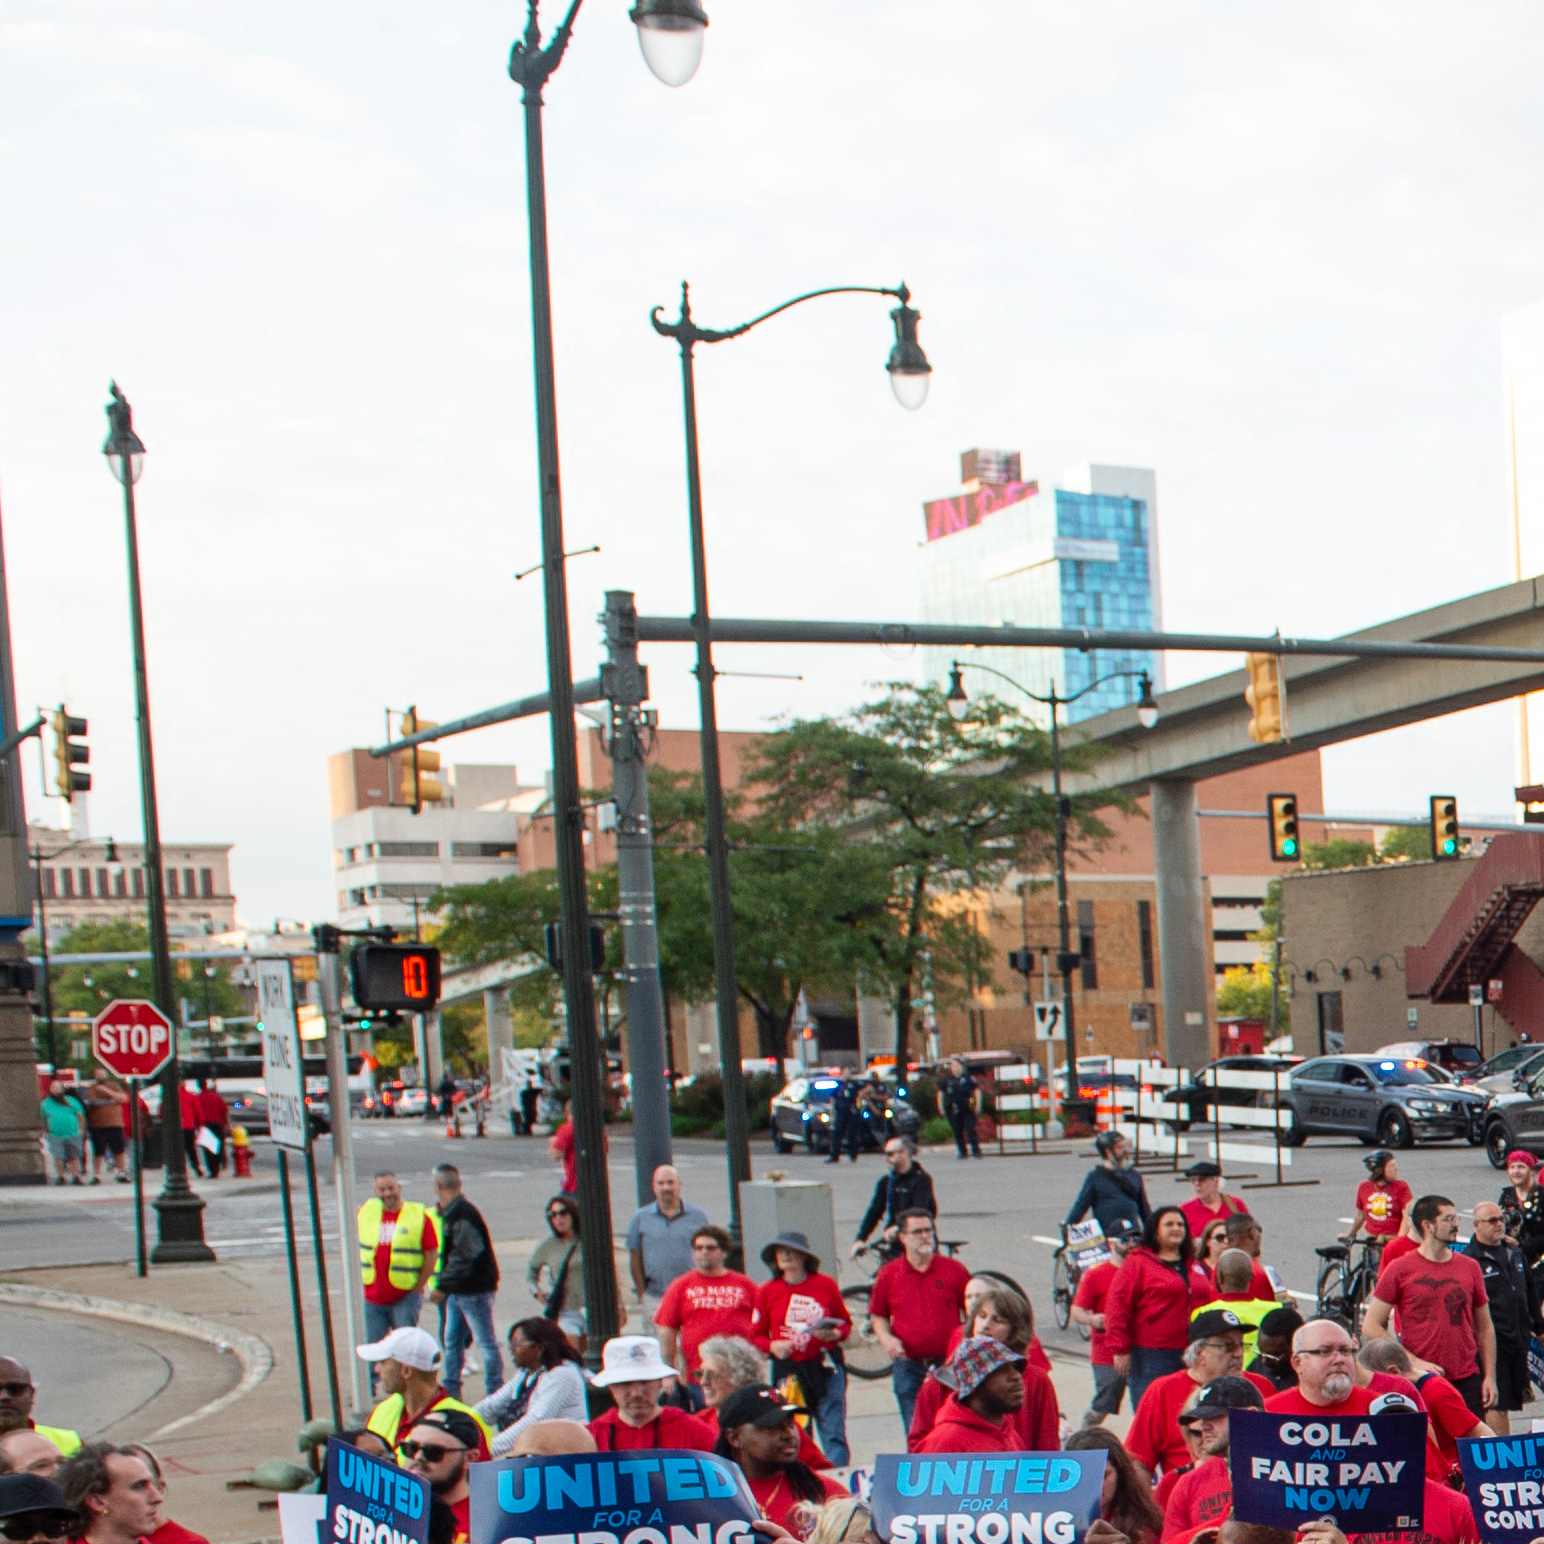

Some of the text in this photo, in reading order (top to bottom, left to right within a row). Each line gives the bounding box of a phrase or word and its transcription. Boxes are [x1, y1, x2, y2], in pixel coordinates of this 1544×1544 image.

[403, 955, 428, 999] 10
[100, 1023, 167, 1054] STOP
[1280, 1421, 1377, 1447] COLA
[1310, 1449, 1346, 1461] AND
[338, 1449, 424, 1520] UNITED
[497, 1458, 738, 1514] UNITED
[897, 1459, 1081, 1497] UNITED
[1251, 1456, 1406, 1486] FAIR PAY
[958, 1498, 1008, 1512] FOR A
[1285, 1487, 1371, 1512] NOW
[593, 1507, 664, 1529] FOR A
